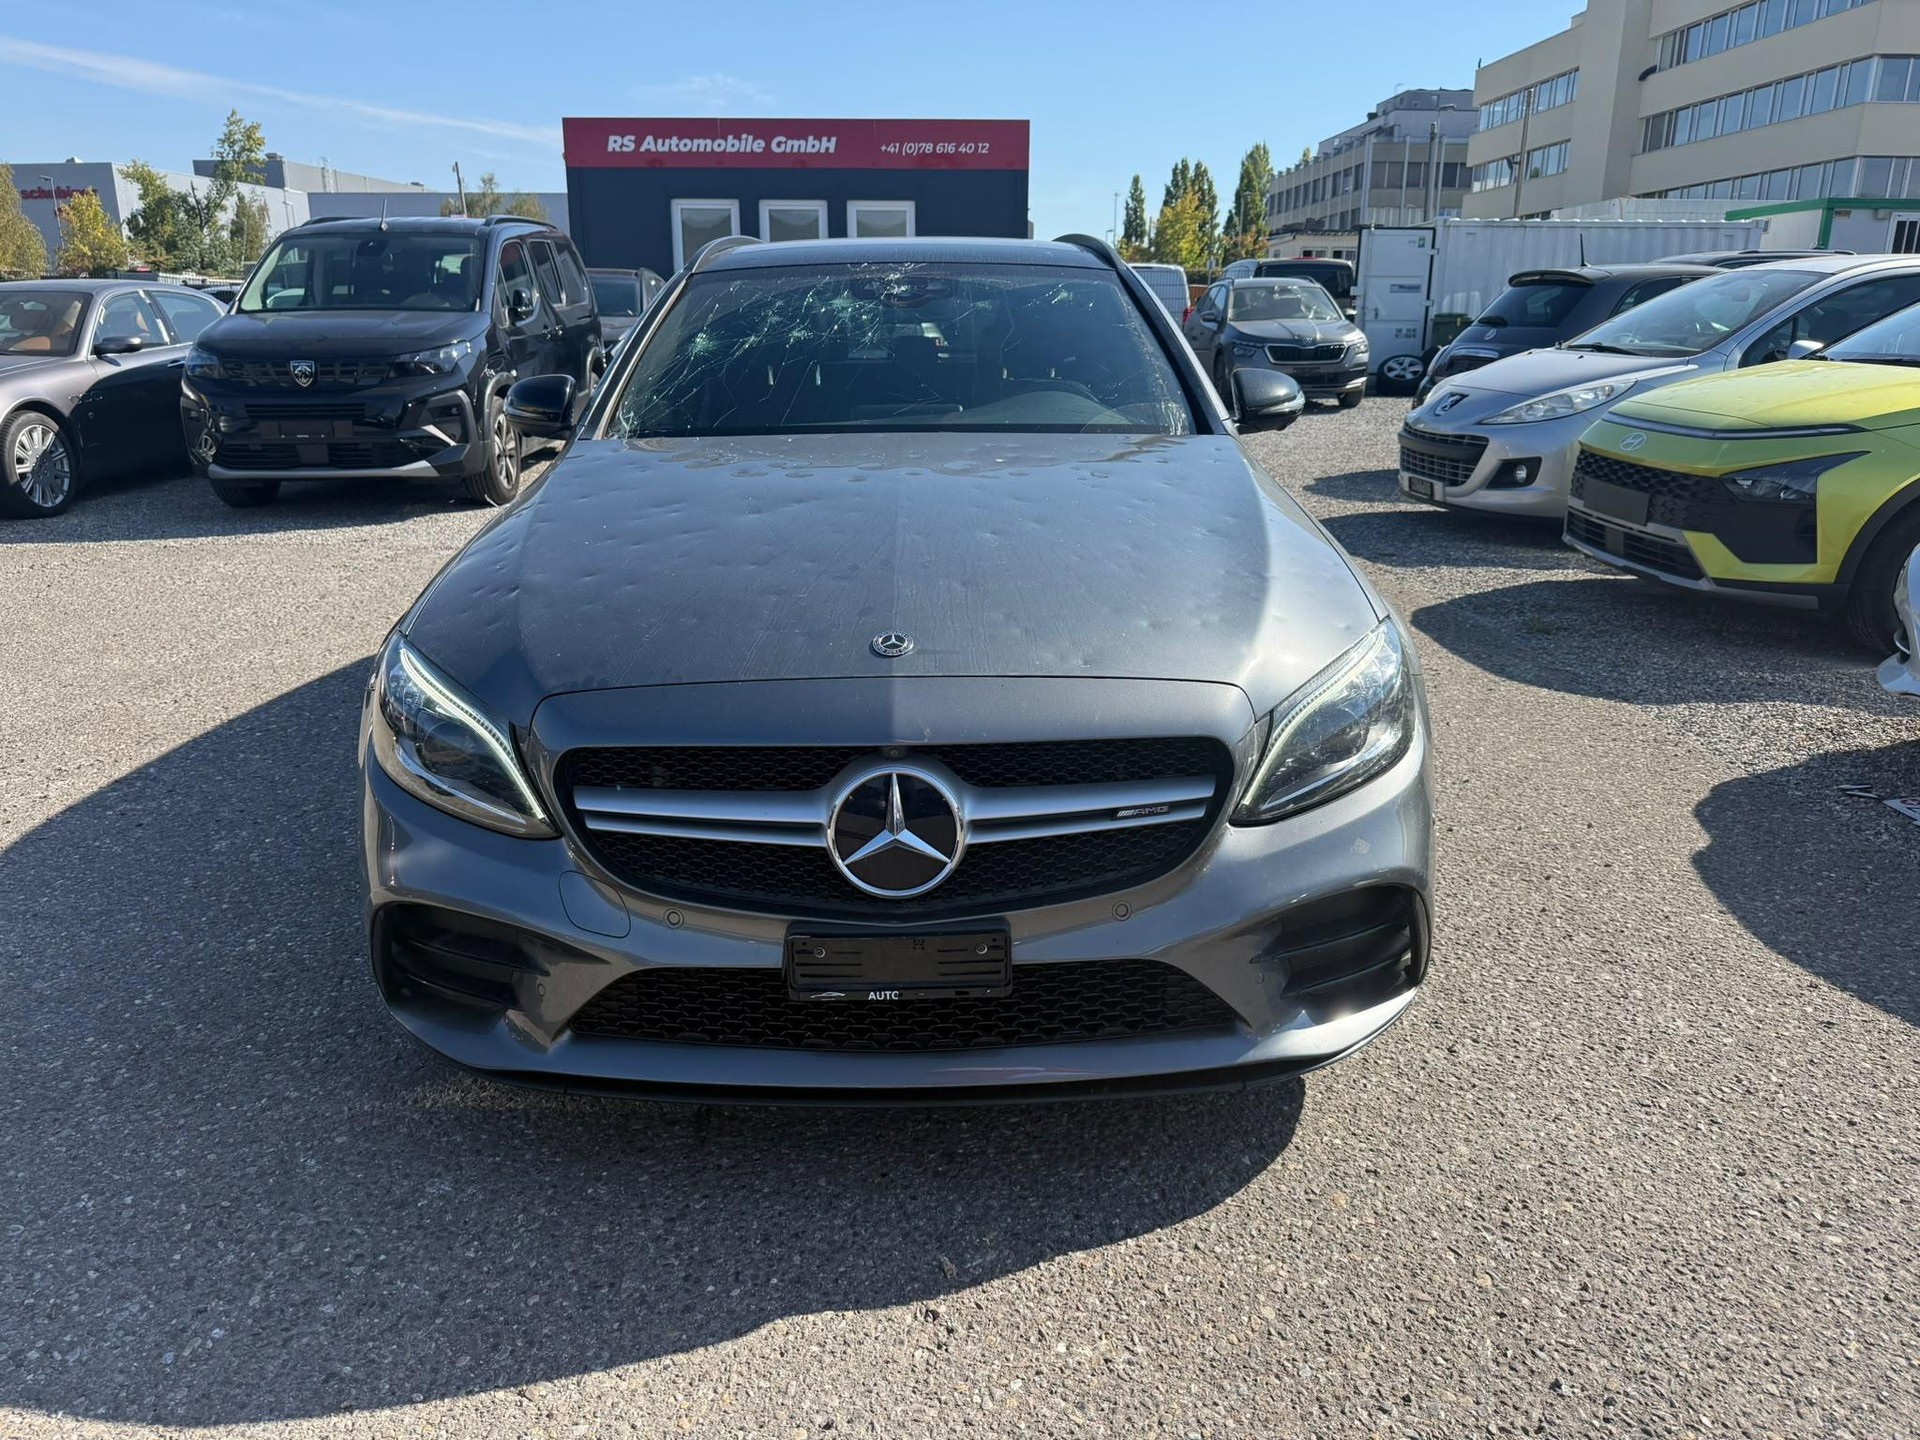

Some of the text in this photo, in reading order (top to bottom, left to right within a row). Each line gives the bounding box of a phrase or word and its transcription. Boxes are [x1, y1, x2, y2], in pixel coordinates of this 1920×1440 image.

[607, 133, 837, 153] RS Automobile GmbH
[880, 142, 990, 156] +41 (0)78 616 40 12
[21, 186, 97, 200] schubi
